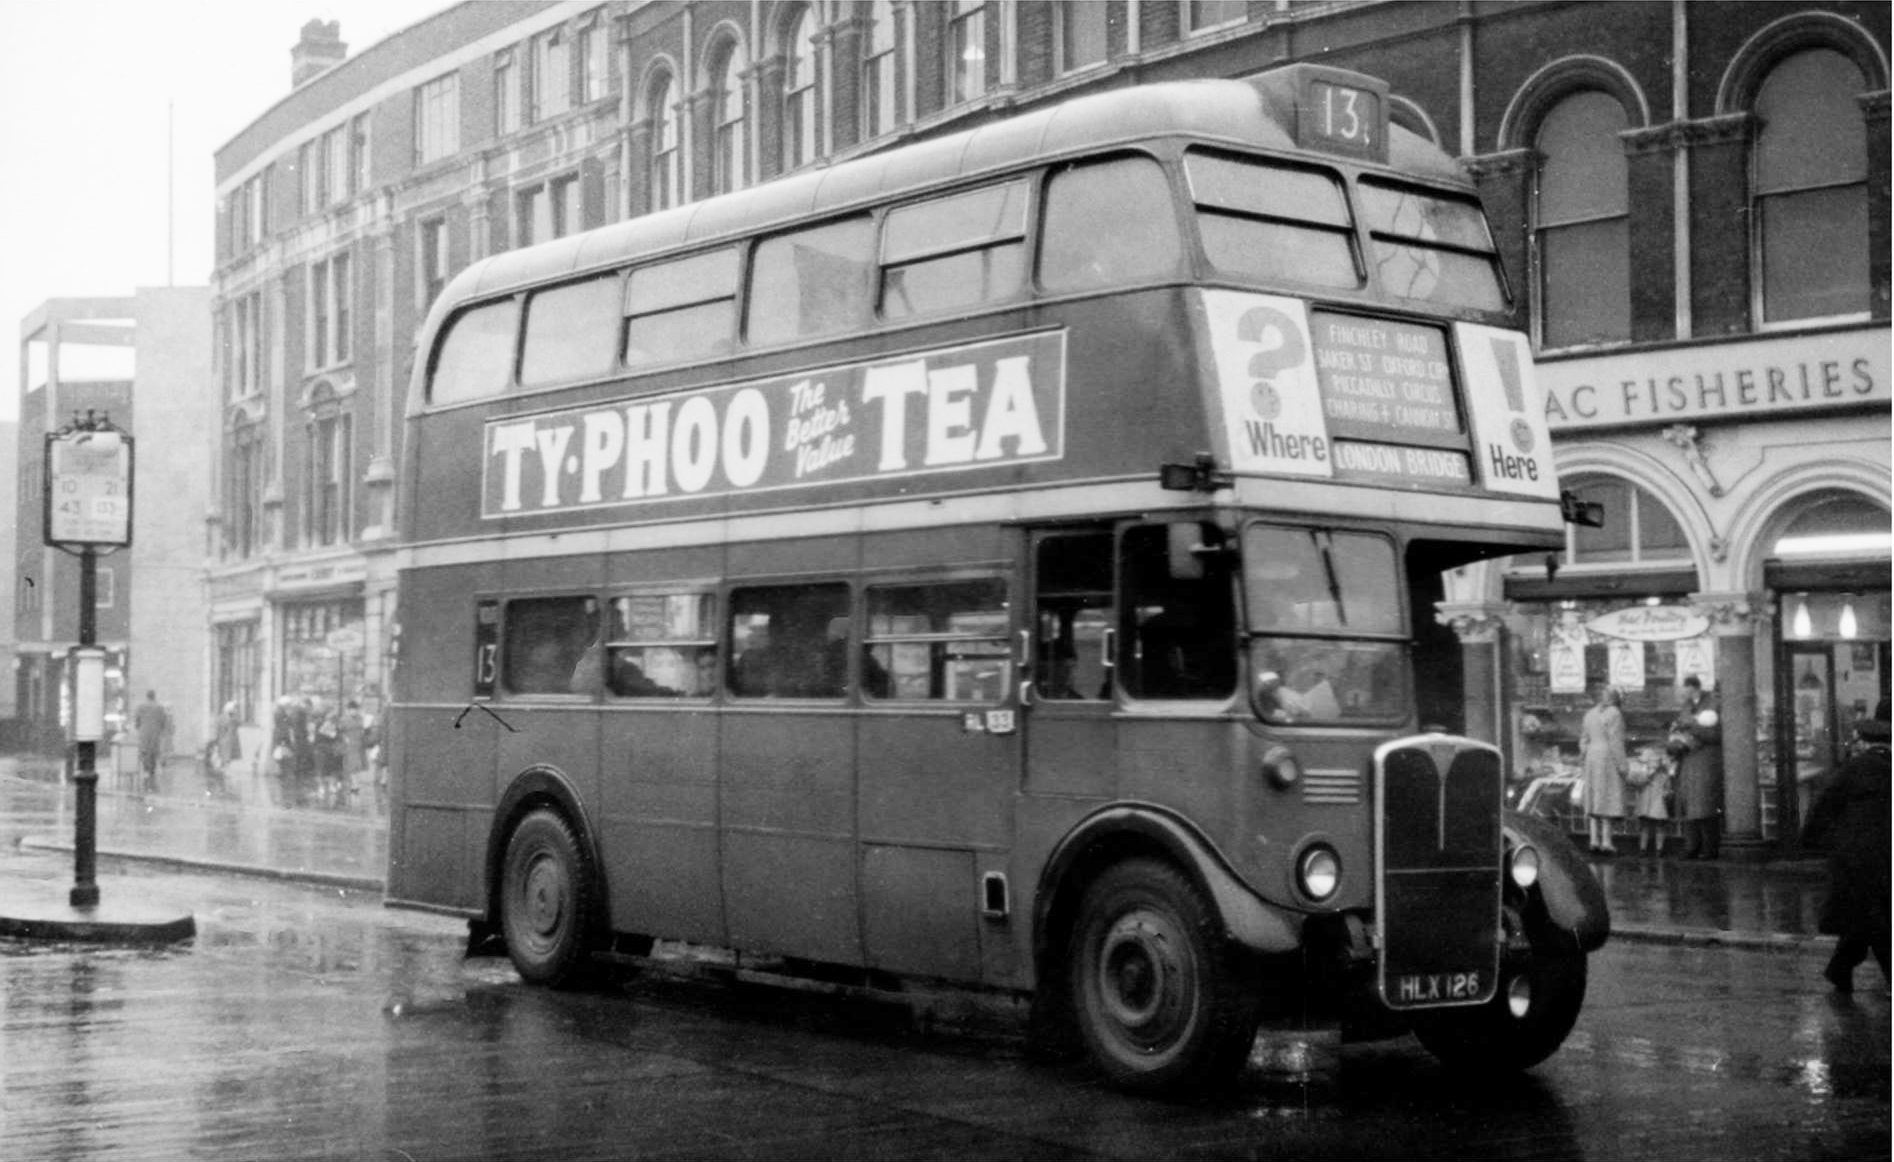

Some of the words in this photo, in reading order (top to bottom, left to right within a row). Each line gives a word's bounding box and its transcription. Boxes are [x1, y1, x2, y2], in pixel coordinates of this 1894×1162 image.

[1325, 86, 1360, 140] 13
[1329, 323, 1387, 349] FINCHLEY
[1396, 331, 1429, 355] ROAD
[1357, 353, 1373, 373] ST
[1381, 355, 1425, 378] OXFORD
[790, 379, 825, 417] The
[1331, 374, 1396, 399] PICCADILLY
[1401, 381, 1442, 404] CIRCUS
[1620, 357, 1874, 416] FISHERIES
[784, 399, 851, 452] Better
[862, 355, 1047, 472] TEA
[795, 434, 855, 478] Value
[1245, 419, 1326, 462] Where
[1334, 442, 1401, 474] LONDON
[1404, 448, 1465, 479] BRIDGE
[1489, 443, 1538, 481] Here
[61, 480, 77, 495] 10
[477, 643, 497, 684] 13
[1400, 973, 1441, 1001] HLX
[1445, 971, 1479, 999] 126
